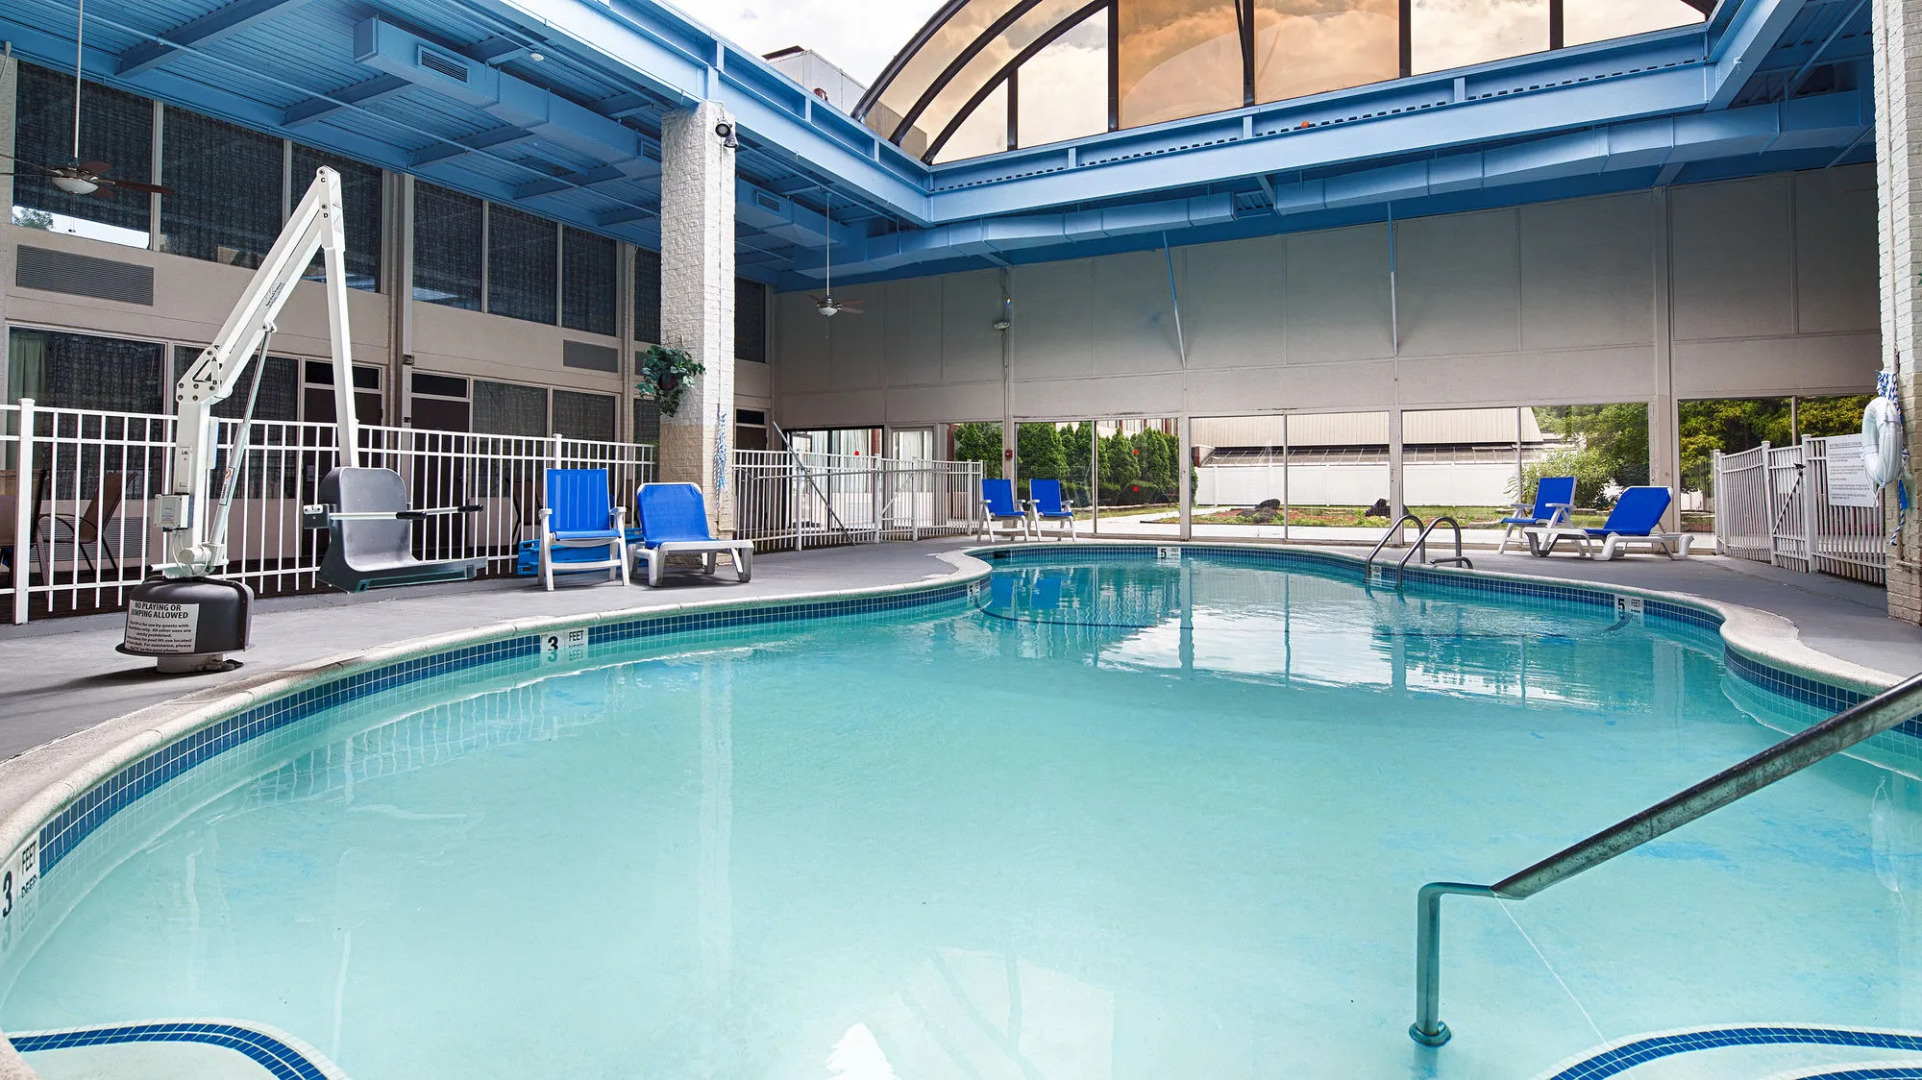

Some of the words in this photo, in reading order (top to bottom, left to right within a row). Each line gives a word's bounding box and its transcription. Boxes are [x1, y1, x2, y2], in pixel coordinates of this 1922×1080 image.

[1160, 547, 1167, 560] 5
[142, 603, 169, 611] PLAYING
[1618, 598, 1625, 610] 5
[548, 636, 558, 651] 3
[569, 630, 584, 641] FEET
[3, 870, 12, 918] 3
[22, 840, 36, 874] FEET
